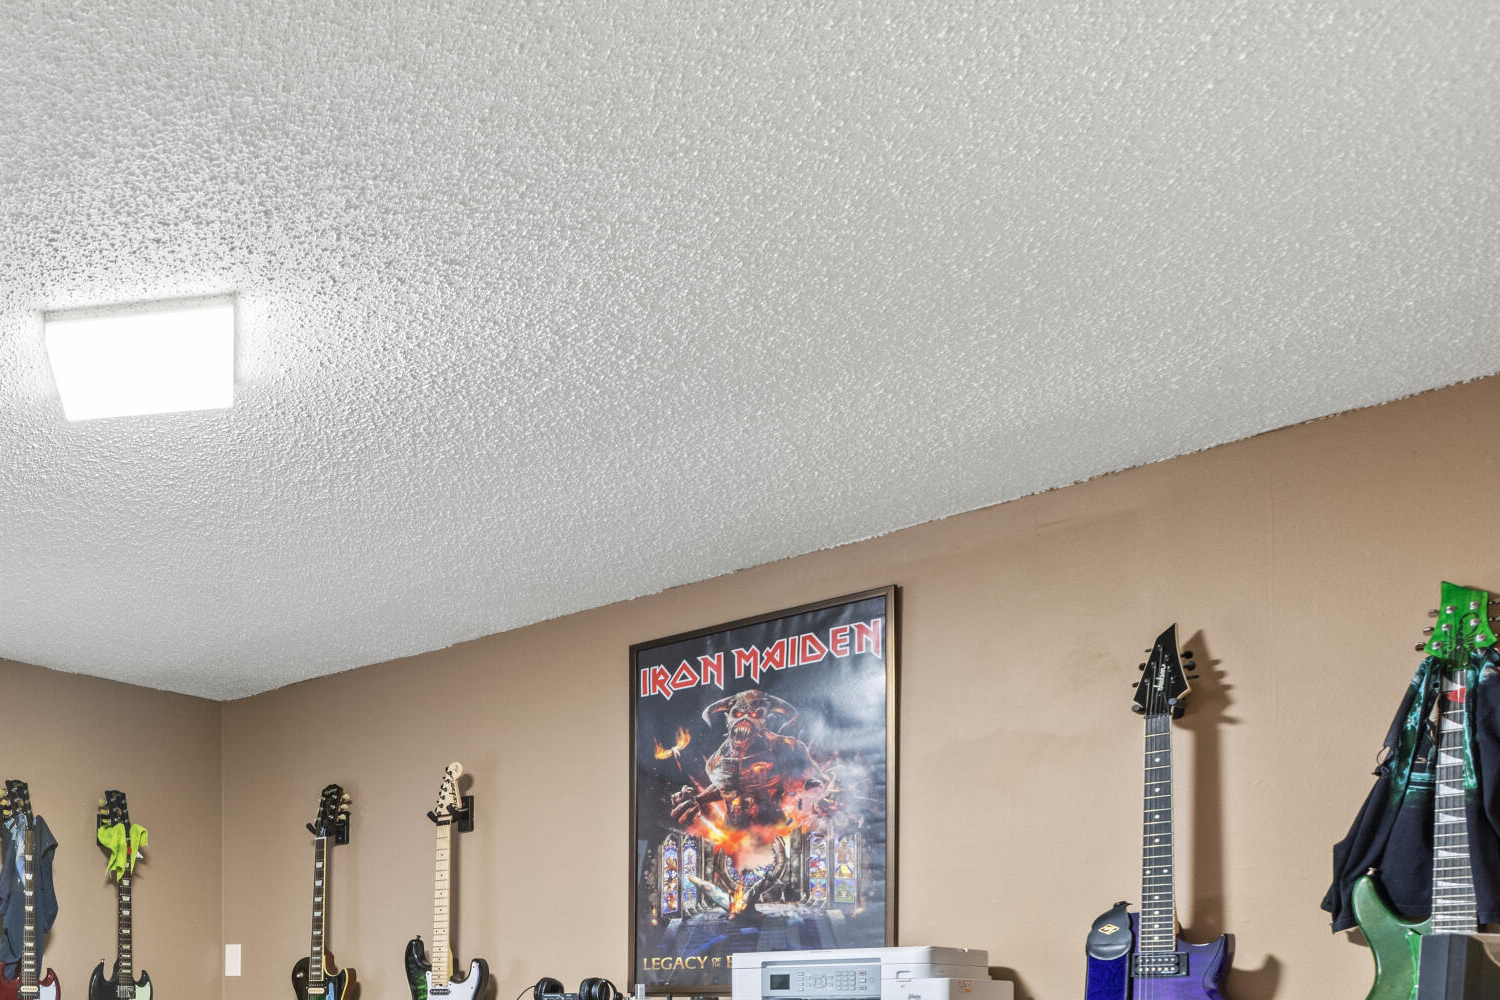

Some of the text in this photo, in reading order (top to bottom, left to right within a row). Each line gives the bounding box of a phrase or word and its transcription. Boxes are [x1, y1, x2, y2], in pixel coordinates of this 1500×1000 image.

[640, 617, 882, 701] IRON MAIDEN
[643, 955, 709, 971] LEGACY
